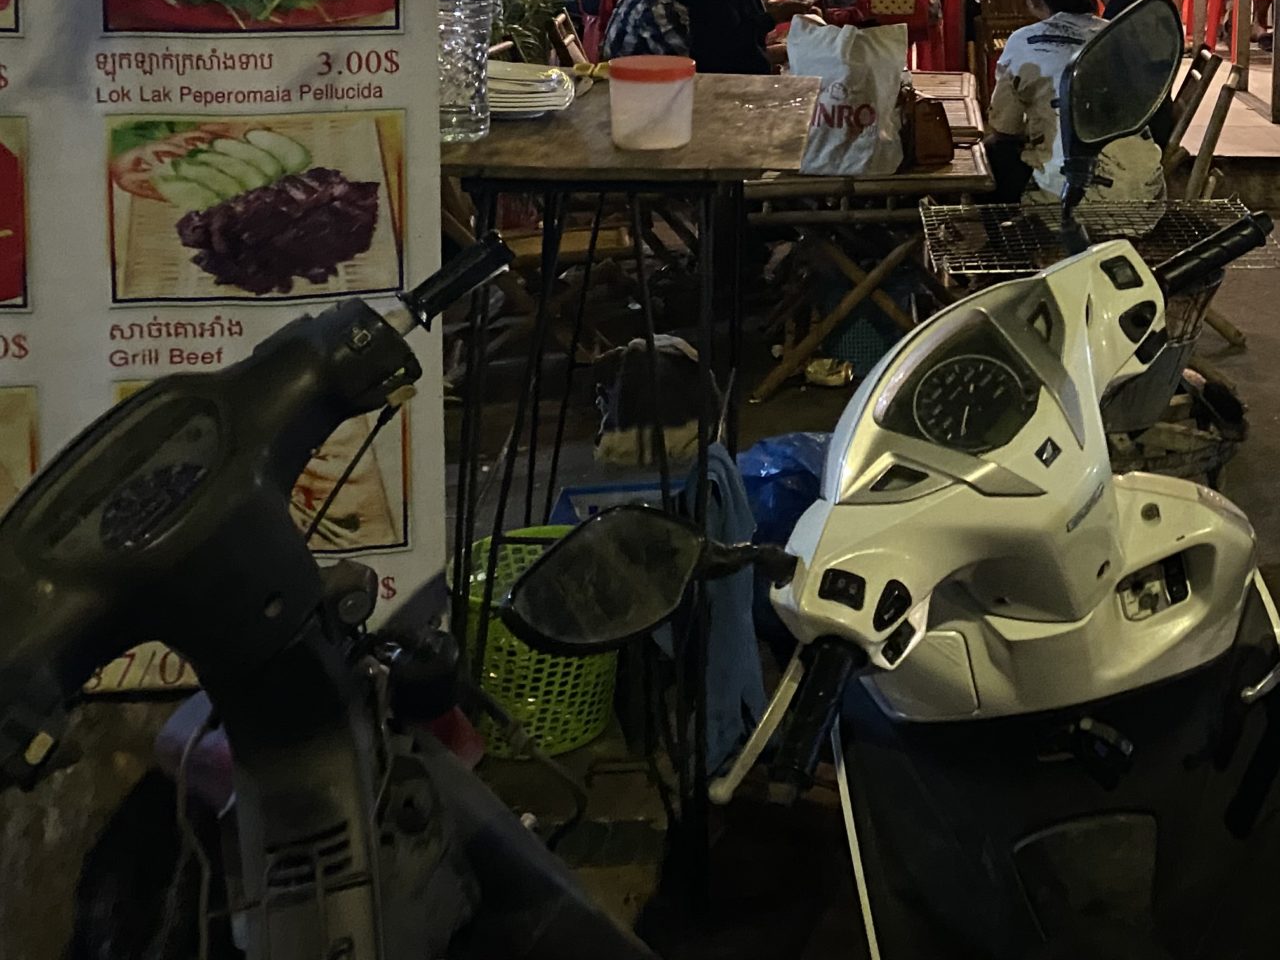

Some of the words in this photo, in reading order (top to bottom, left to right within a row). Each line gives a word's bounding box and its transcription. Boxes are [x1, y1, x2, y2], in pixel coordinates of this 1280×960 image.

[317, 49, 400, 76] 3.00$
[96, 86, 131, 103] Lok
[140, 86, 172, 102] Lak
[180, 85, 291, 106] Peperomaia
[299, 82, 383, 101] Pellucida
[109, 348, 159, 367] Grill
[169, 347, 223, 365] Beef
